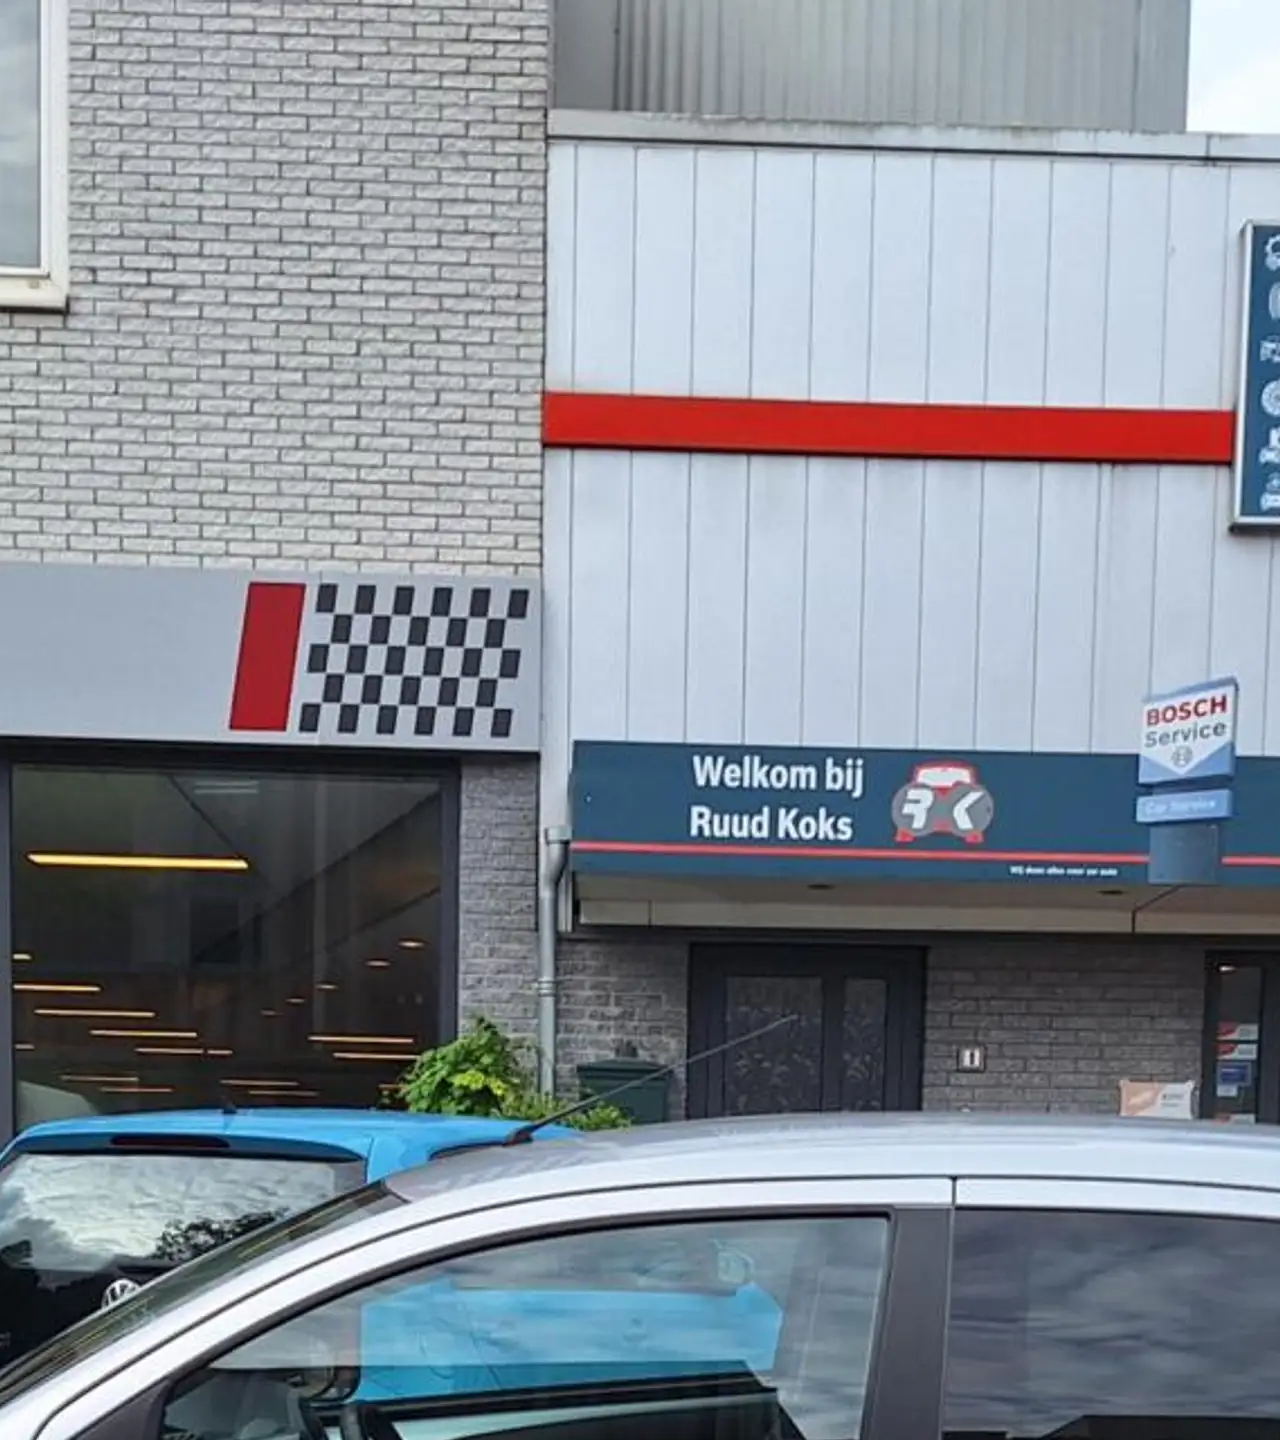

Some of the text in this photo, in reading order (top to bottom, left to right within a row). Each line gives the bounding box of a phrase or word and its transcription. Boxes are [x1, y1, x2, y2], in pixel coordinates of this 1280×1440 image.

[1145, 693, 1228, 727] BOSCH
[1144, 721, 1227, 749] Service
[692, 755, 864, 798] Welkom bij
[690, 804, 854, 841] Ruud Koks
